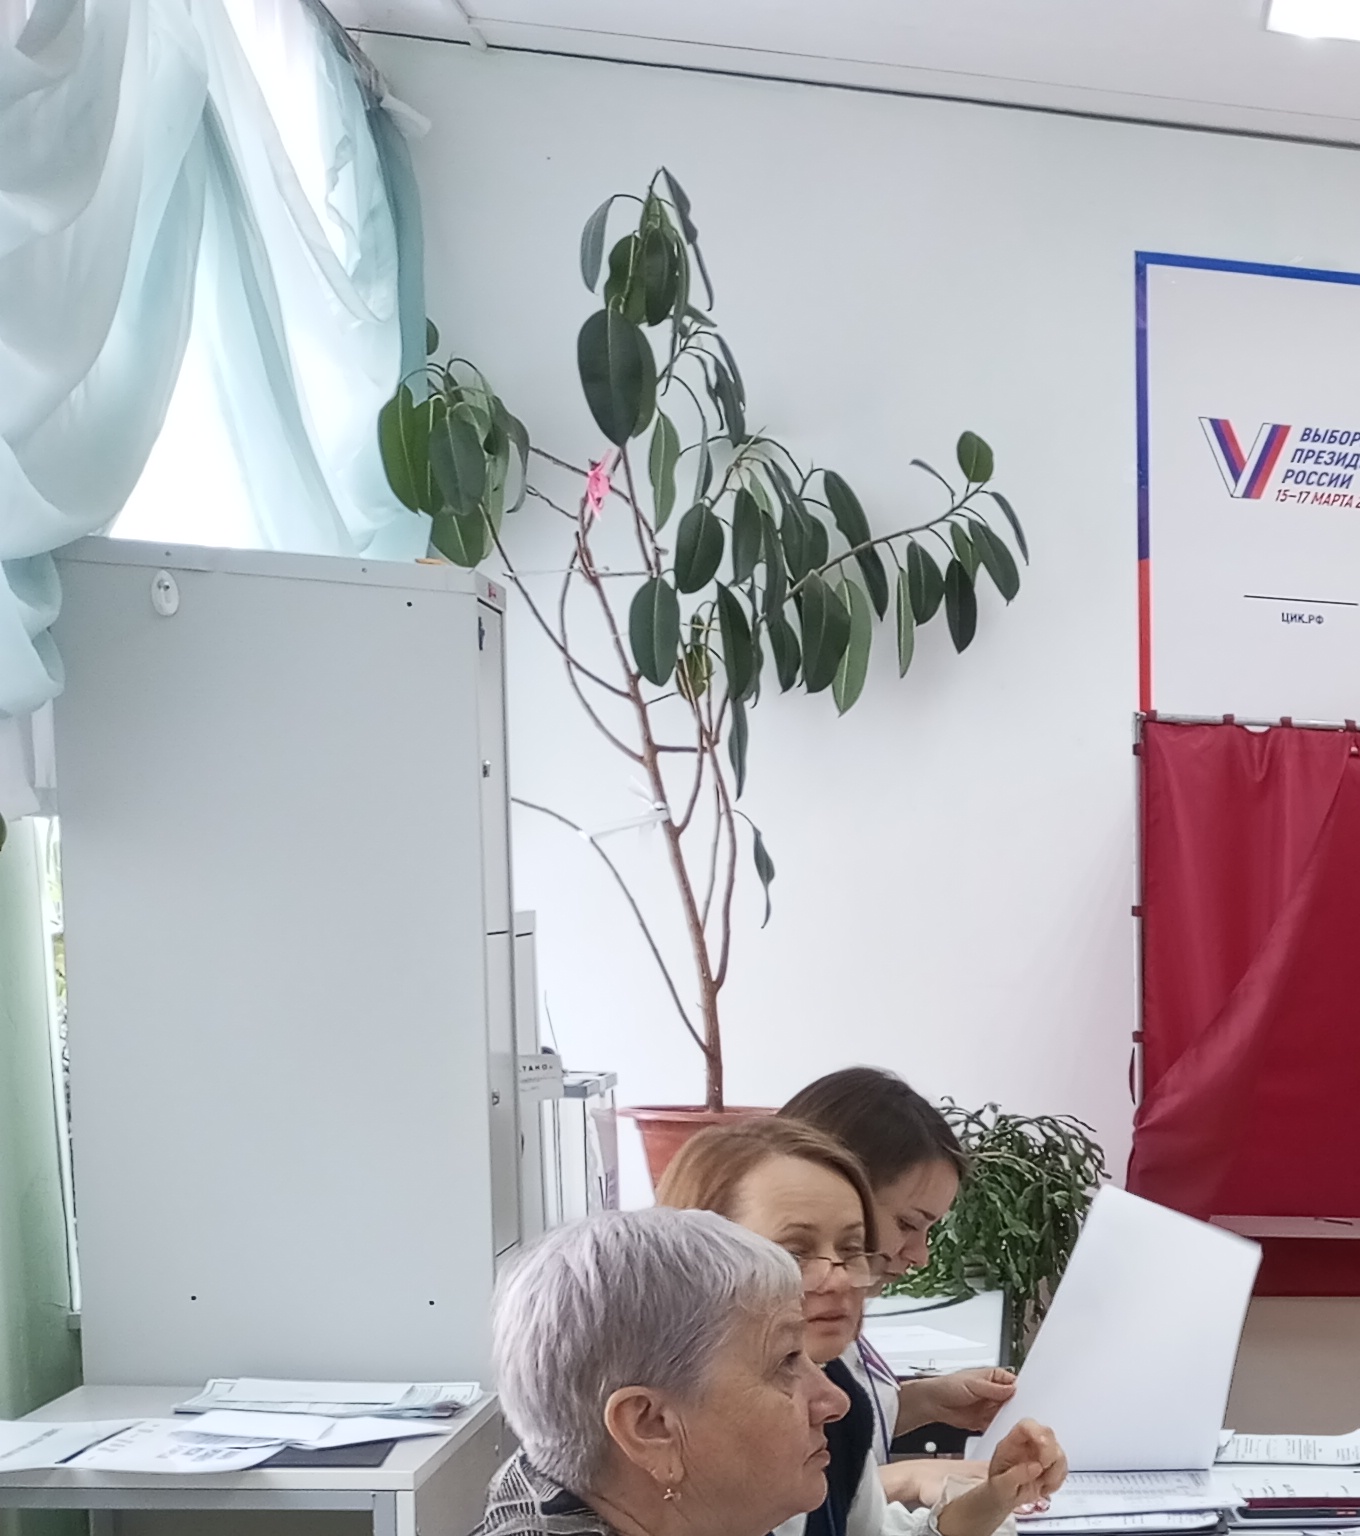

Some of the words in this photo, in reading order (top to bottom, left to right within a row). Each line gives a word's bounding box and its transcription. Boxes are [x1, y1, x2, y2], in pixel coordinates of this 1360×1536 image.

[1281, 468, 1355, 490] РОССИИ
[1310, 491, 1355, 509] МАРТА
[1281, 612, 1325, 626] ЦИК.РФ
